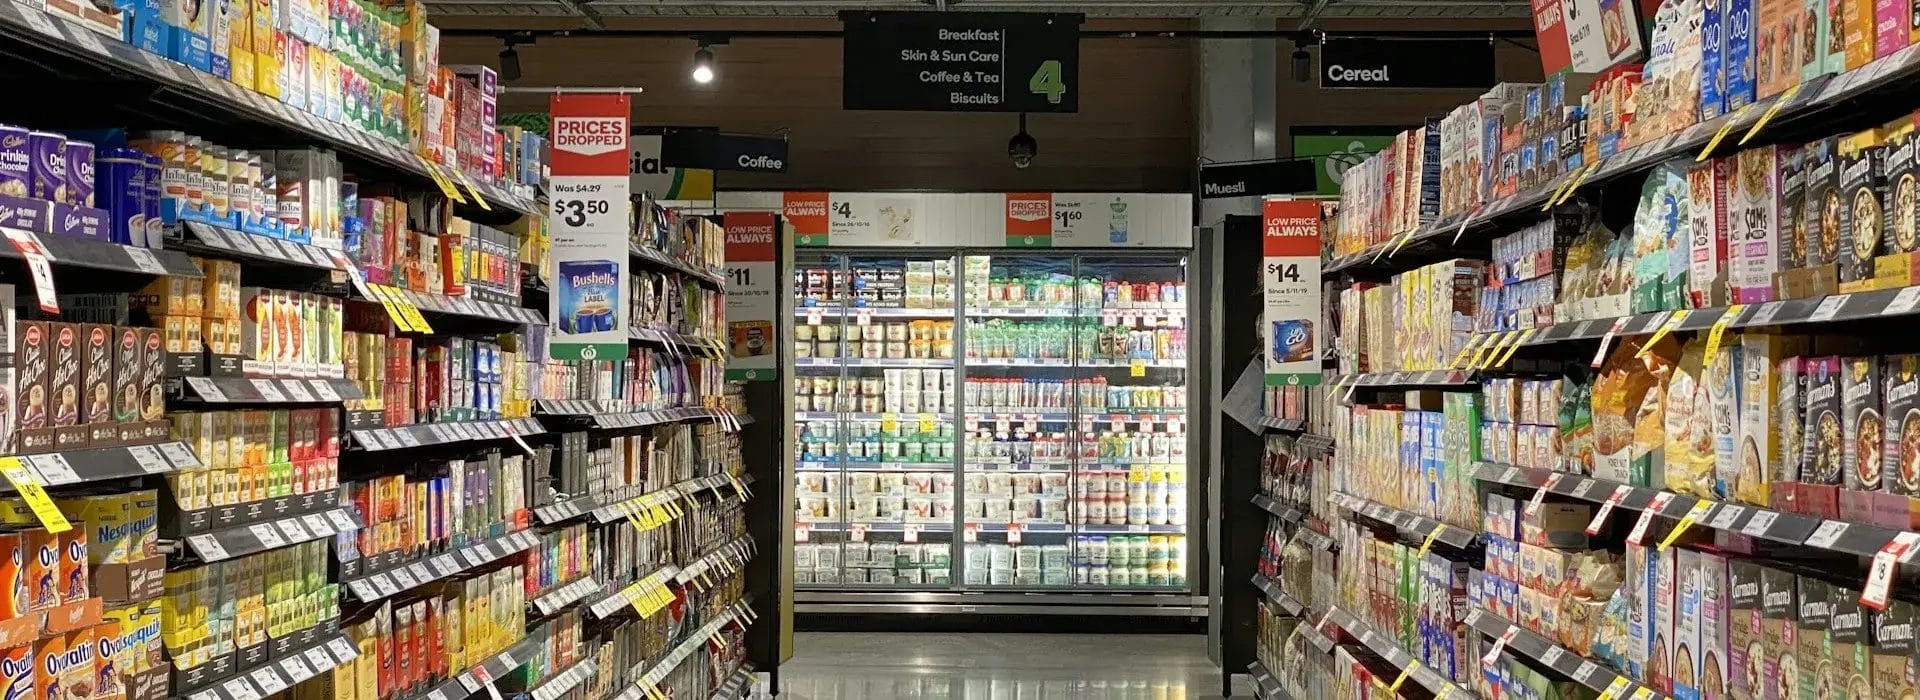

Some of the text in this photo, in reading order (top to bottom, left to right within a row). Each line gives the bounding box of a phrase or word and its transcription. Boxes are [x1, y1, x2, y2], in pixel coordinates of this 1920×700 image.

[1537, 2, 1561, 33] ALWAYS
[939, 29, 999, 41] Breakfast
[901, 50, 999, 62] Skin & Sun Care
[919, 71, 999, 83] Coffee & Tea
[1327, 64, 1390, 82] Cereal
[1029, 59, 1066, 104] 4
[950, 92, 999, 104] Biscuits
[558, 121, 622, 134] PRICES
[557, 135, 622, 146] DROPPED
[738, 154, 782, 169] Coffee
[576, 184, 601, 193] $4.29
[1205, 181, 1245, 195] Muesli
[786, 207, 826, 217] ALWAYS
[832, 201, 852, 219] $4
[1267, 217, 1317, 226] LOW PRICE
[726, 225, 772, 234] LOW PRICE
[1266, 226, 1318, 237] ALWAYS
[727, 233, 773, 244] ALWAYS
[728, 268, 750, 286] $11
[1268, 263, 1300, 283] $14
[572, 271, 615, 288] Bushells
[584, 294, 605, 303] LABEL
